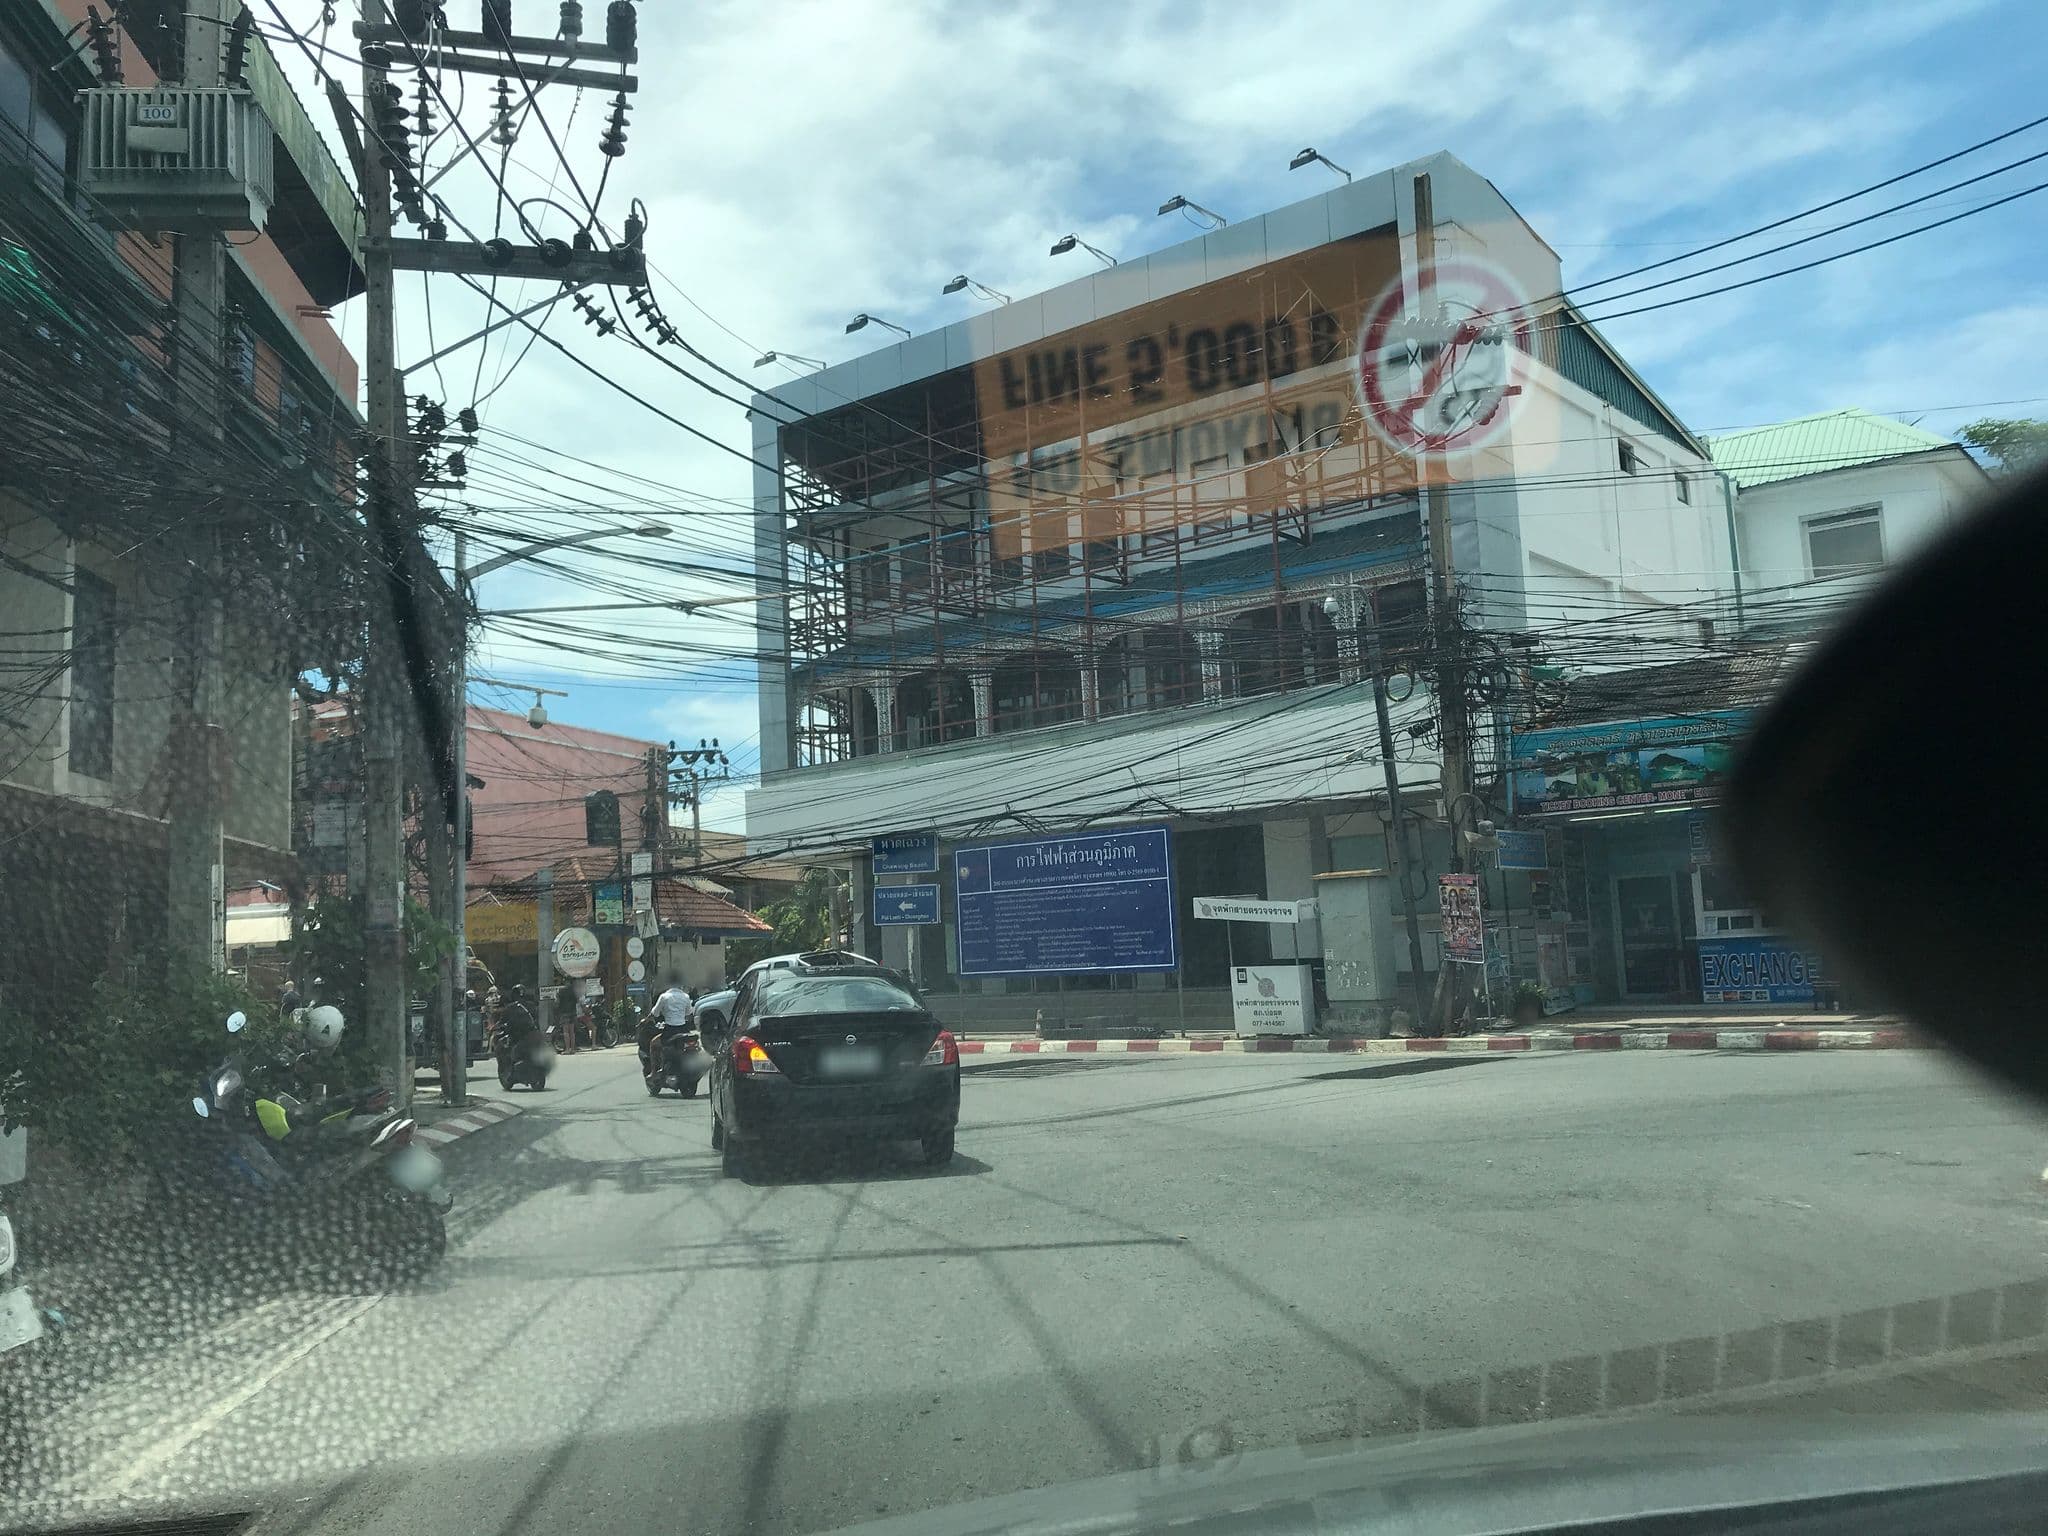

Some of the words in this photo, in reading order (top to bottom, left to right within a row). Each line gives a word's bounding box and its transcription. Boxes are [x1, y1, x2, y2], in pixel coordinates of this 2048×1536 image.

[143, 108, 171, 120] 100
[1573, 796, 1615, 809] BOOKING
[1212, 903, 1292, 915] จุดพักสายตรวจจราจร
[1702, 952, 1819, 988] EXCHANGE
